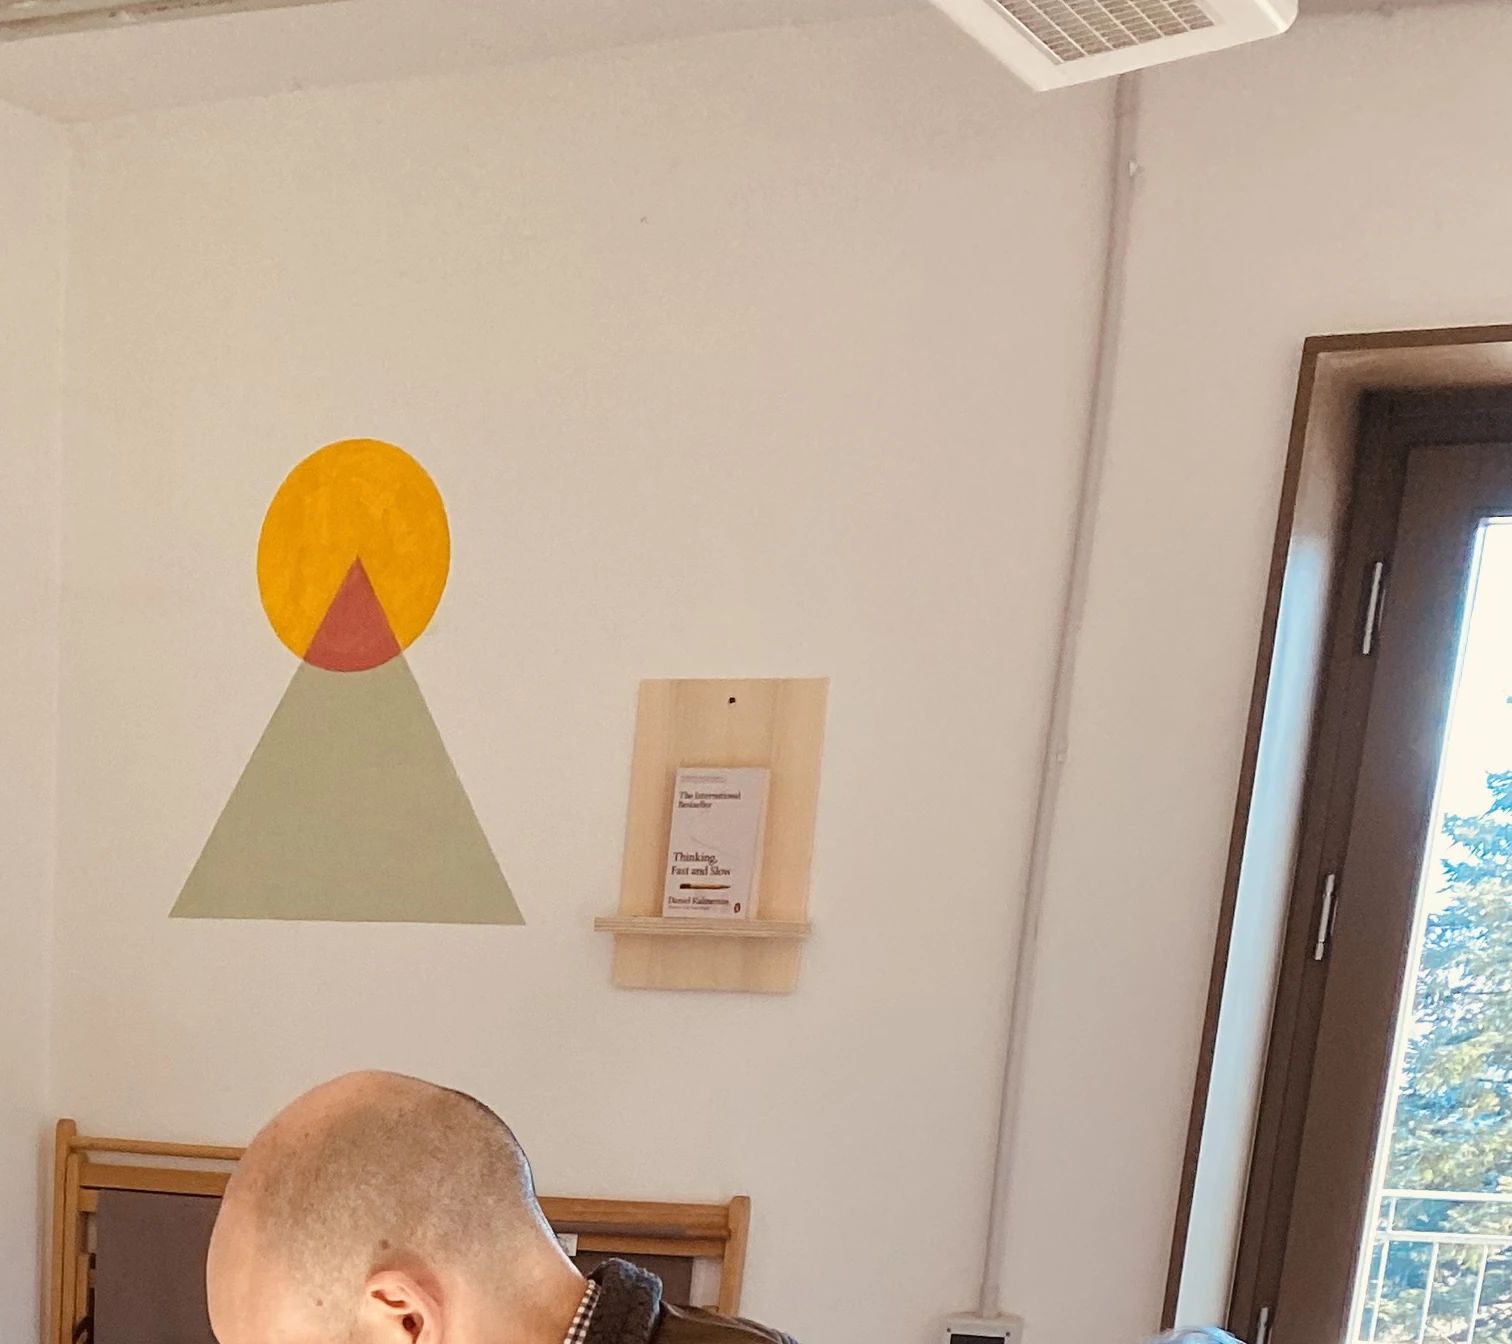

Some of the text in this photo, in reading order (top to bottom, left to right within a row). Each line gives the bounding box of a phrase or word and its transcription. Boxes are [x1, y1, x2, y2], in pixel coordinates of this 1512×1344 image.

[679, 791, 741, 800] The International
[678, 800, 712, 809] Bestseller
[673, 851, 718, 866] Thinking,
[671, 866, 731, 876] Fast and Slow
